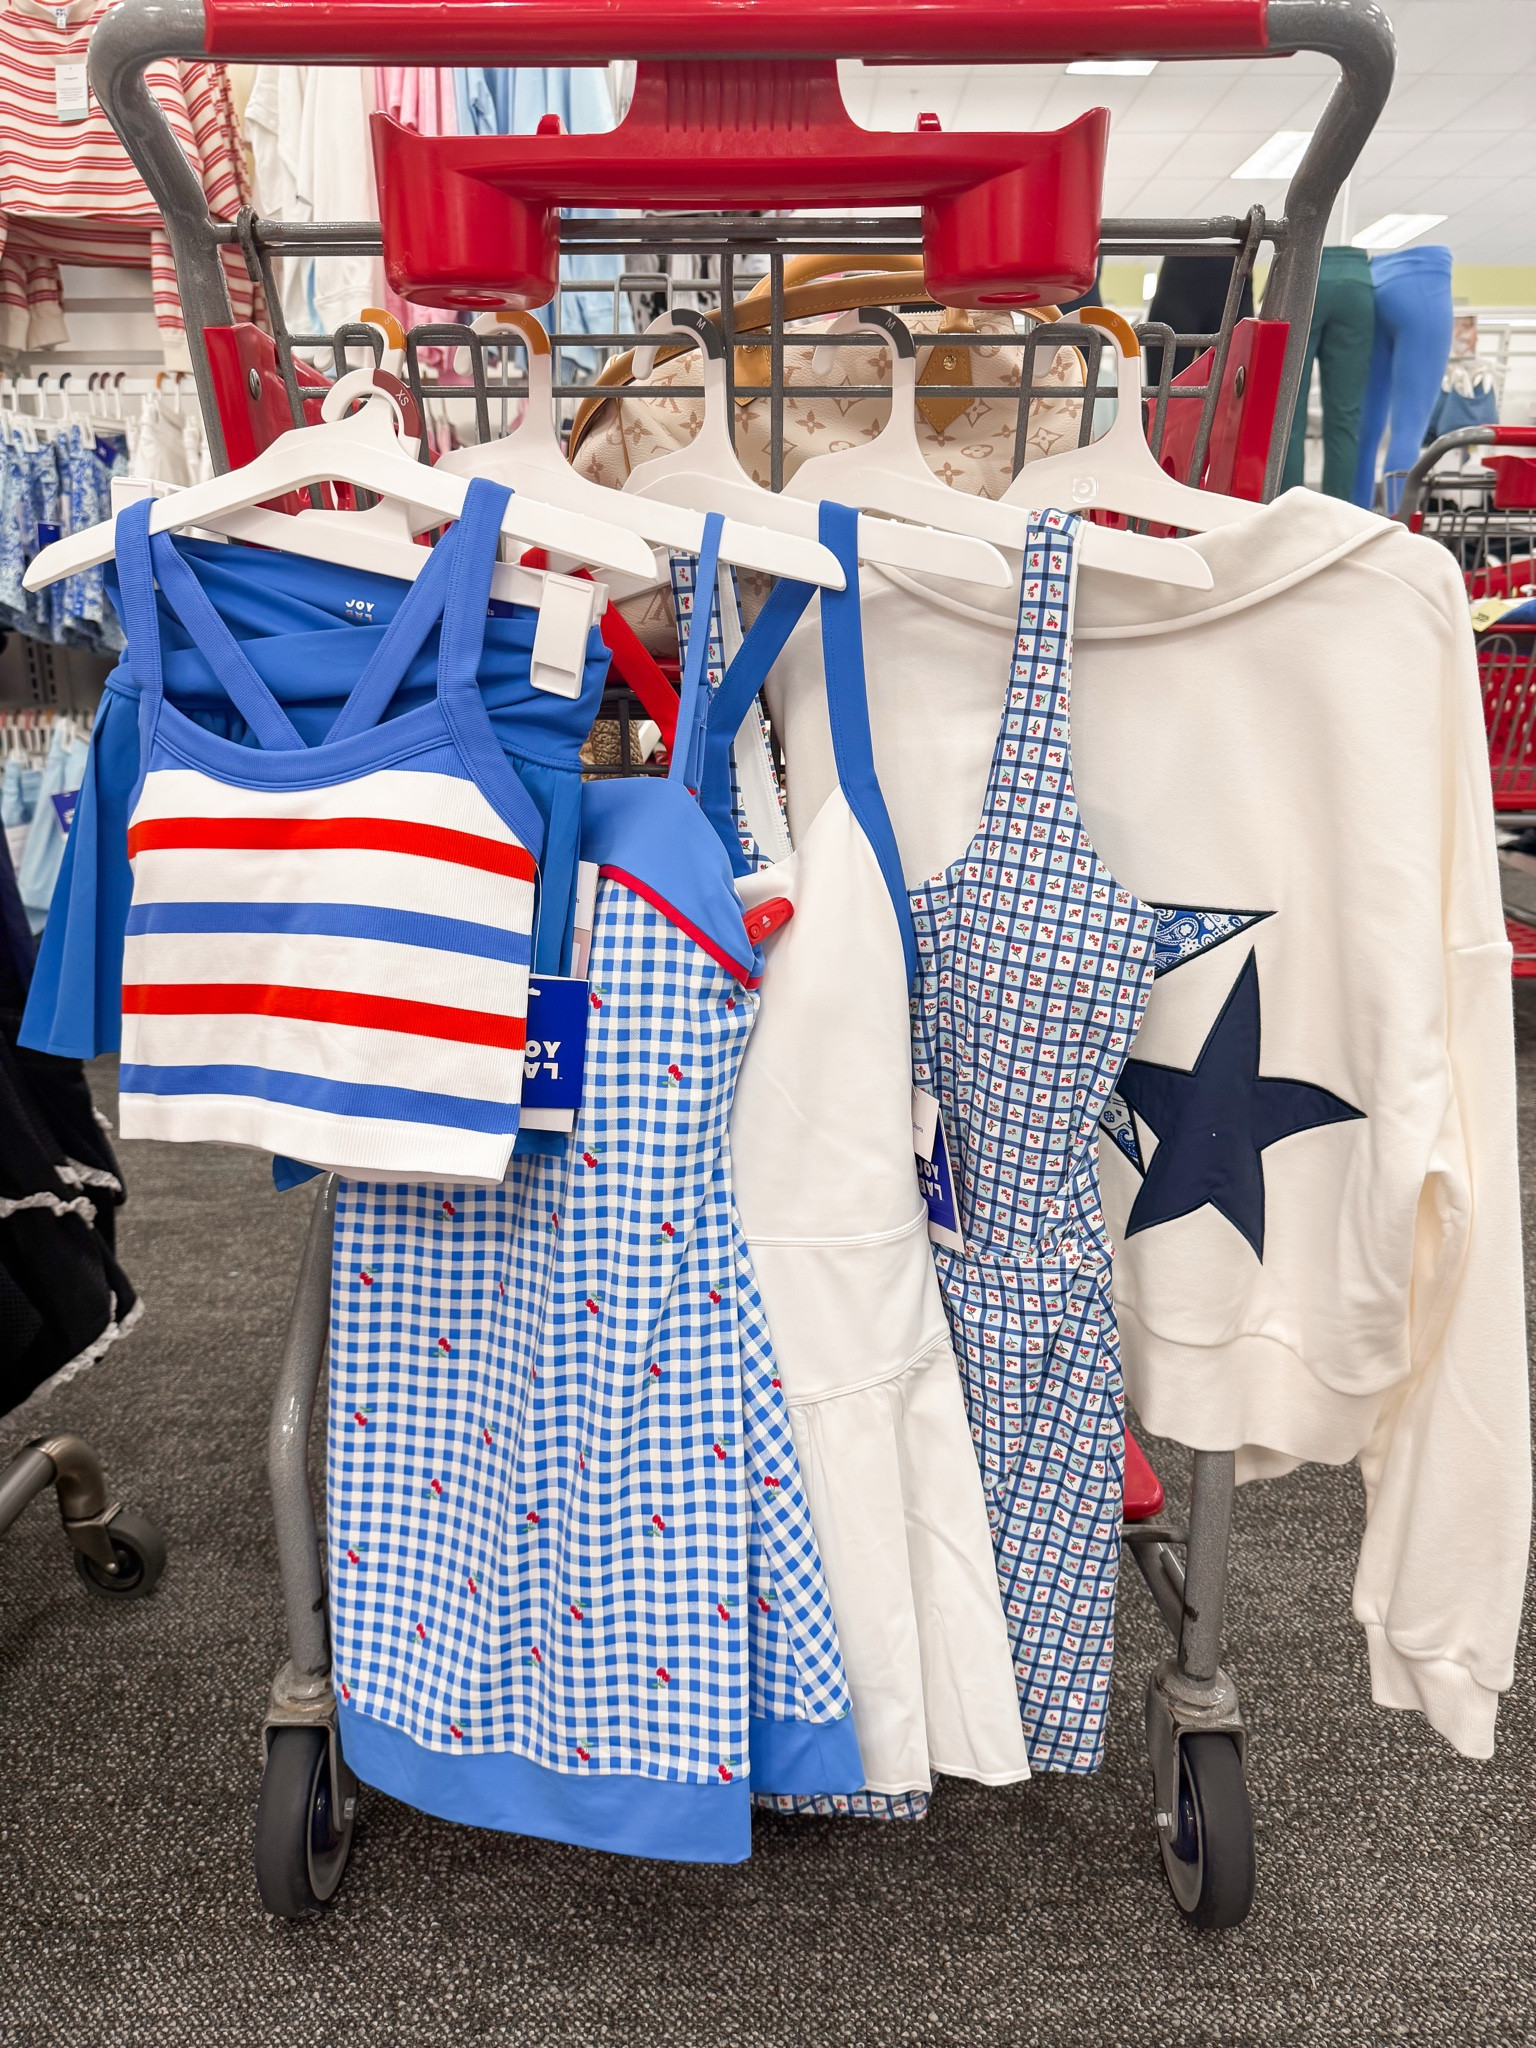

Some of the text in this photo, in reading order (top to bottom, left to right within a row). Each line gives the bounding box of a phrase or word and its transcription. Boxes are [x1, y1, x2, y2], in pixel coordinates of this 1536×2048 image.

[384, 316, 393, 325] S
[695, 317, 707, 331] M
[885, 317, 897, 330] M
[395, 389, 410, 407] XS
[345, 599, 375, 613] JOY
[525, 1040, 562, 1059] OY
[524, 1062, 559, 1080] LA
